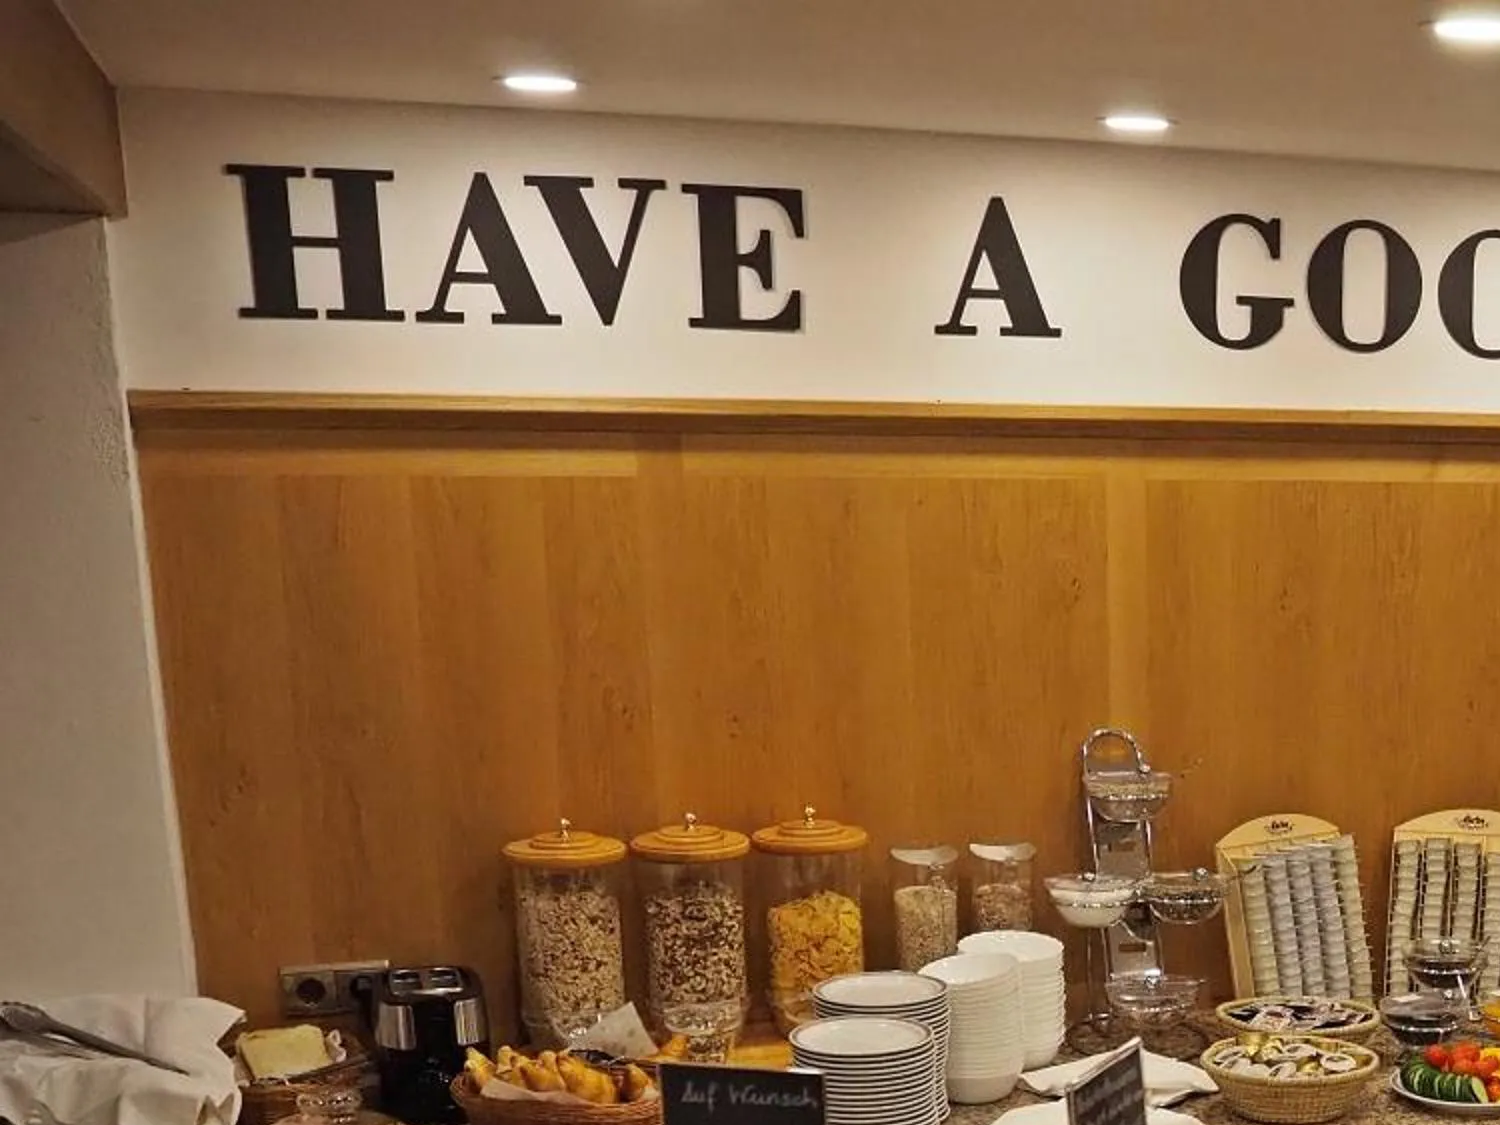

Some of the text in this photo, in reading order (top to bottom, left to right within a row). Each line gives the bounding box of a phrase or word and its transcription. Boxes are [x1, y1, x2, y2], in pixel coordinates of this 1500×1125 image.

[221, 163, 804, 332] HAVE
[935, 197, 1061, 337] A
[681, 1081, 818, 1113] Auf Wunsch
